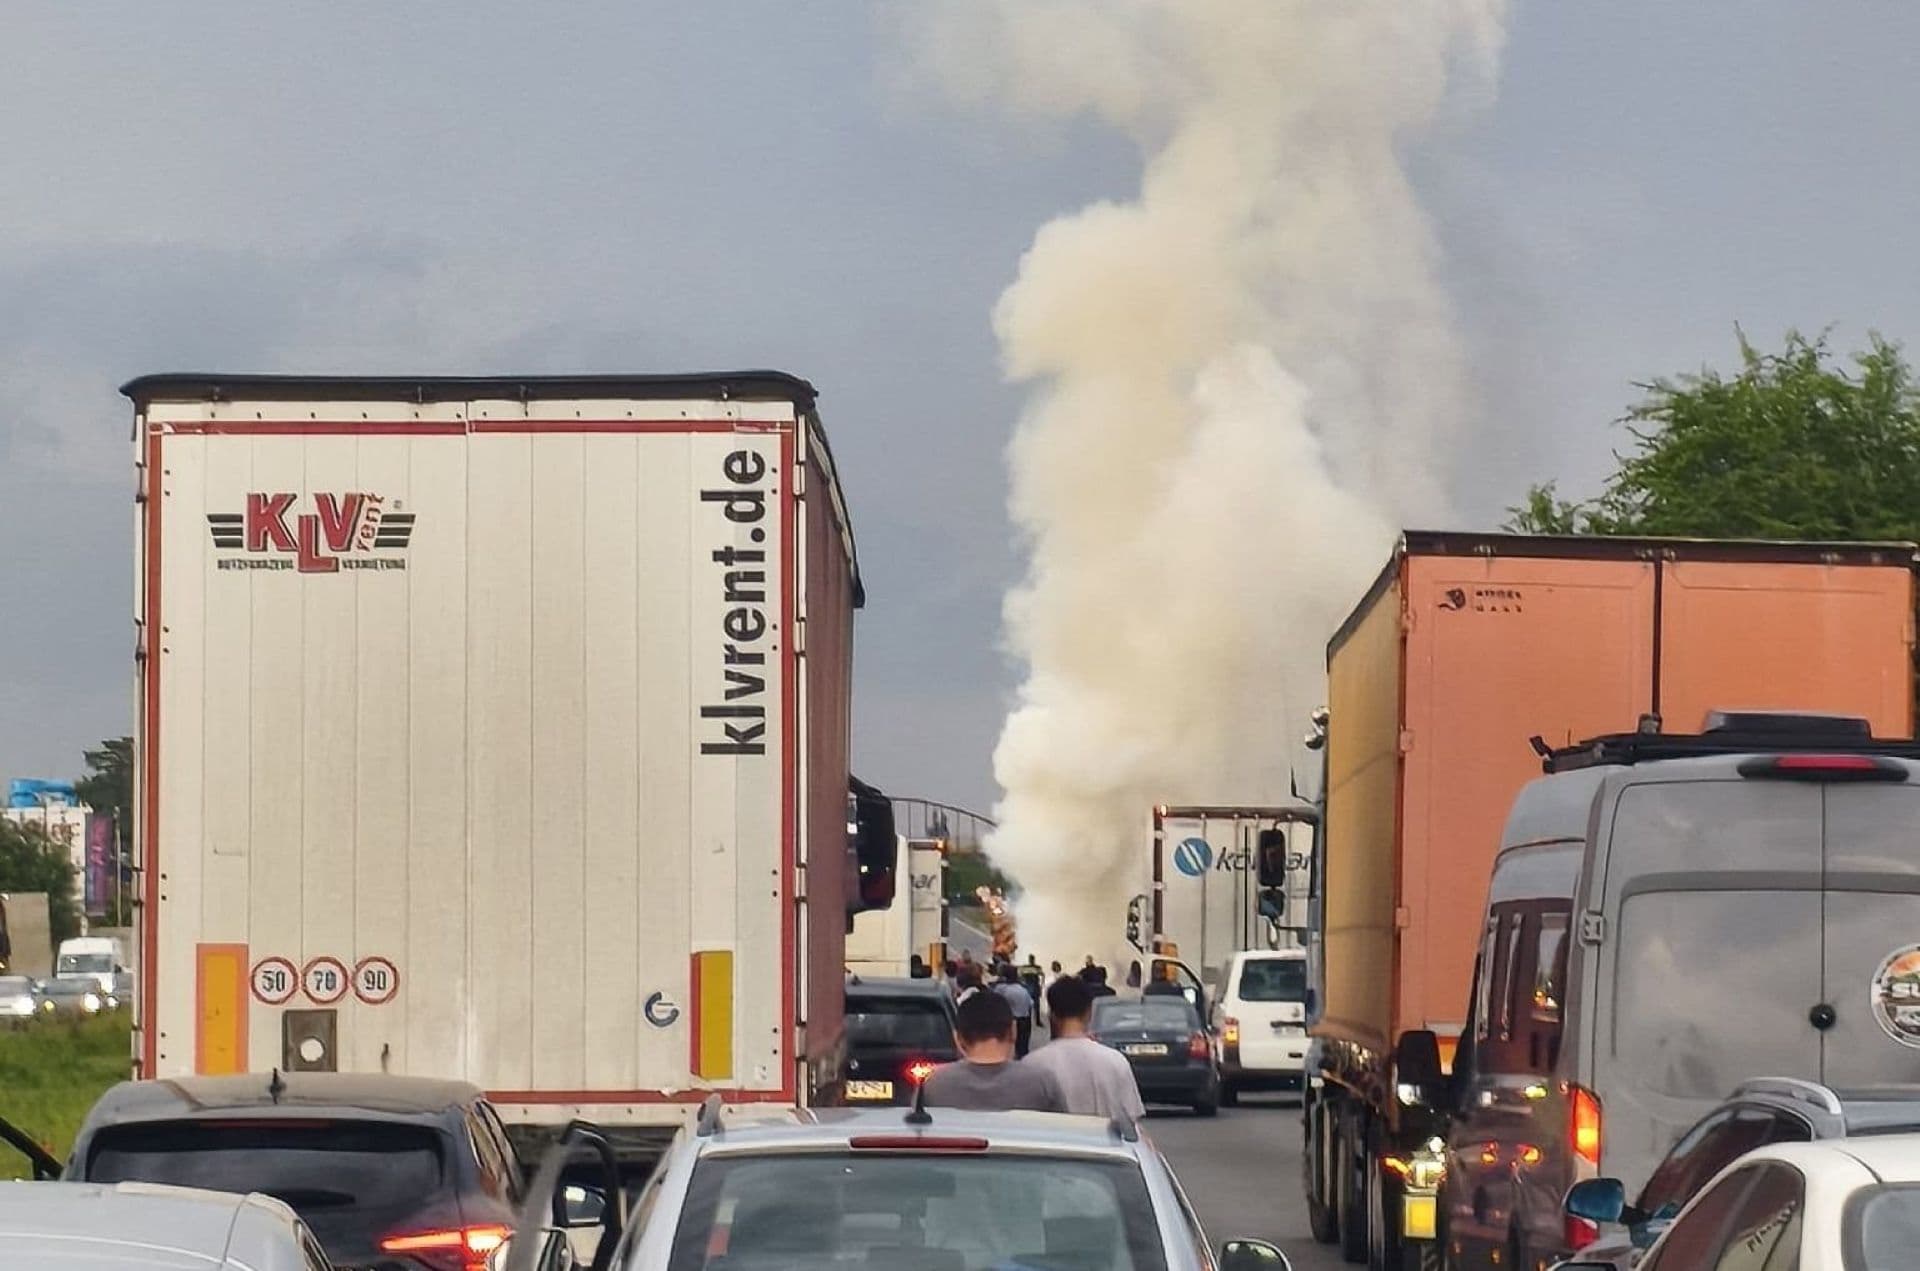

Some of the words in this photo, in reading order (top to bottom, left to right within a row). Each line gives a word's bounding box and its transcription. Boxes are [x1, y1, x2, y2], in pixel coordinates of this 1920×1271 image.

[247, 493, 364, 572] KLV
[356, 492, 385, 552] rent
[700, 450, 766, 755] klvrent.de
[262, 969, 286, 992] 50
[313, 969, 337, 991] 70
[364, 969, 387, 991] 90
